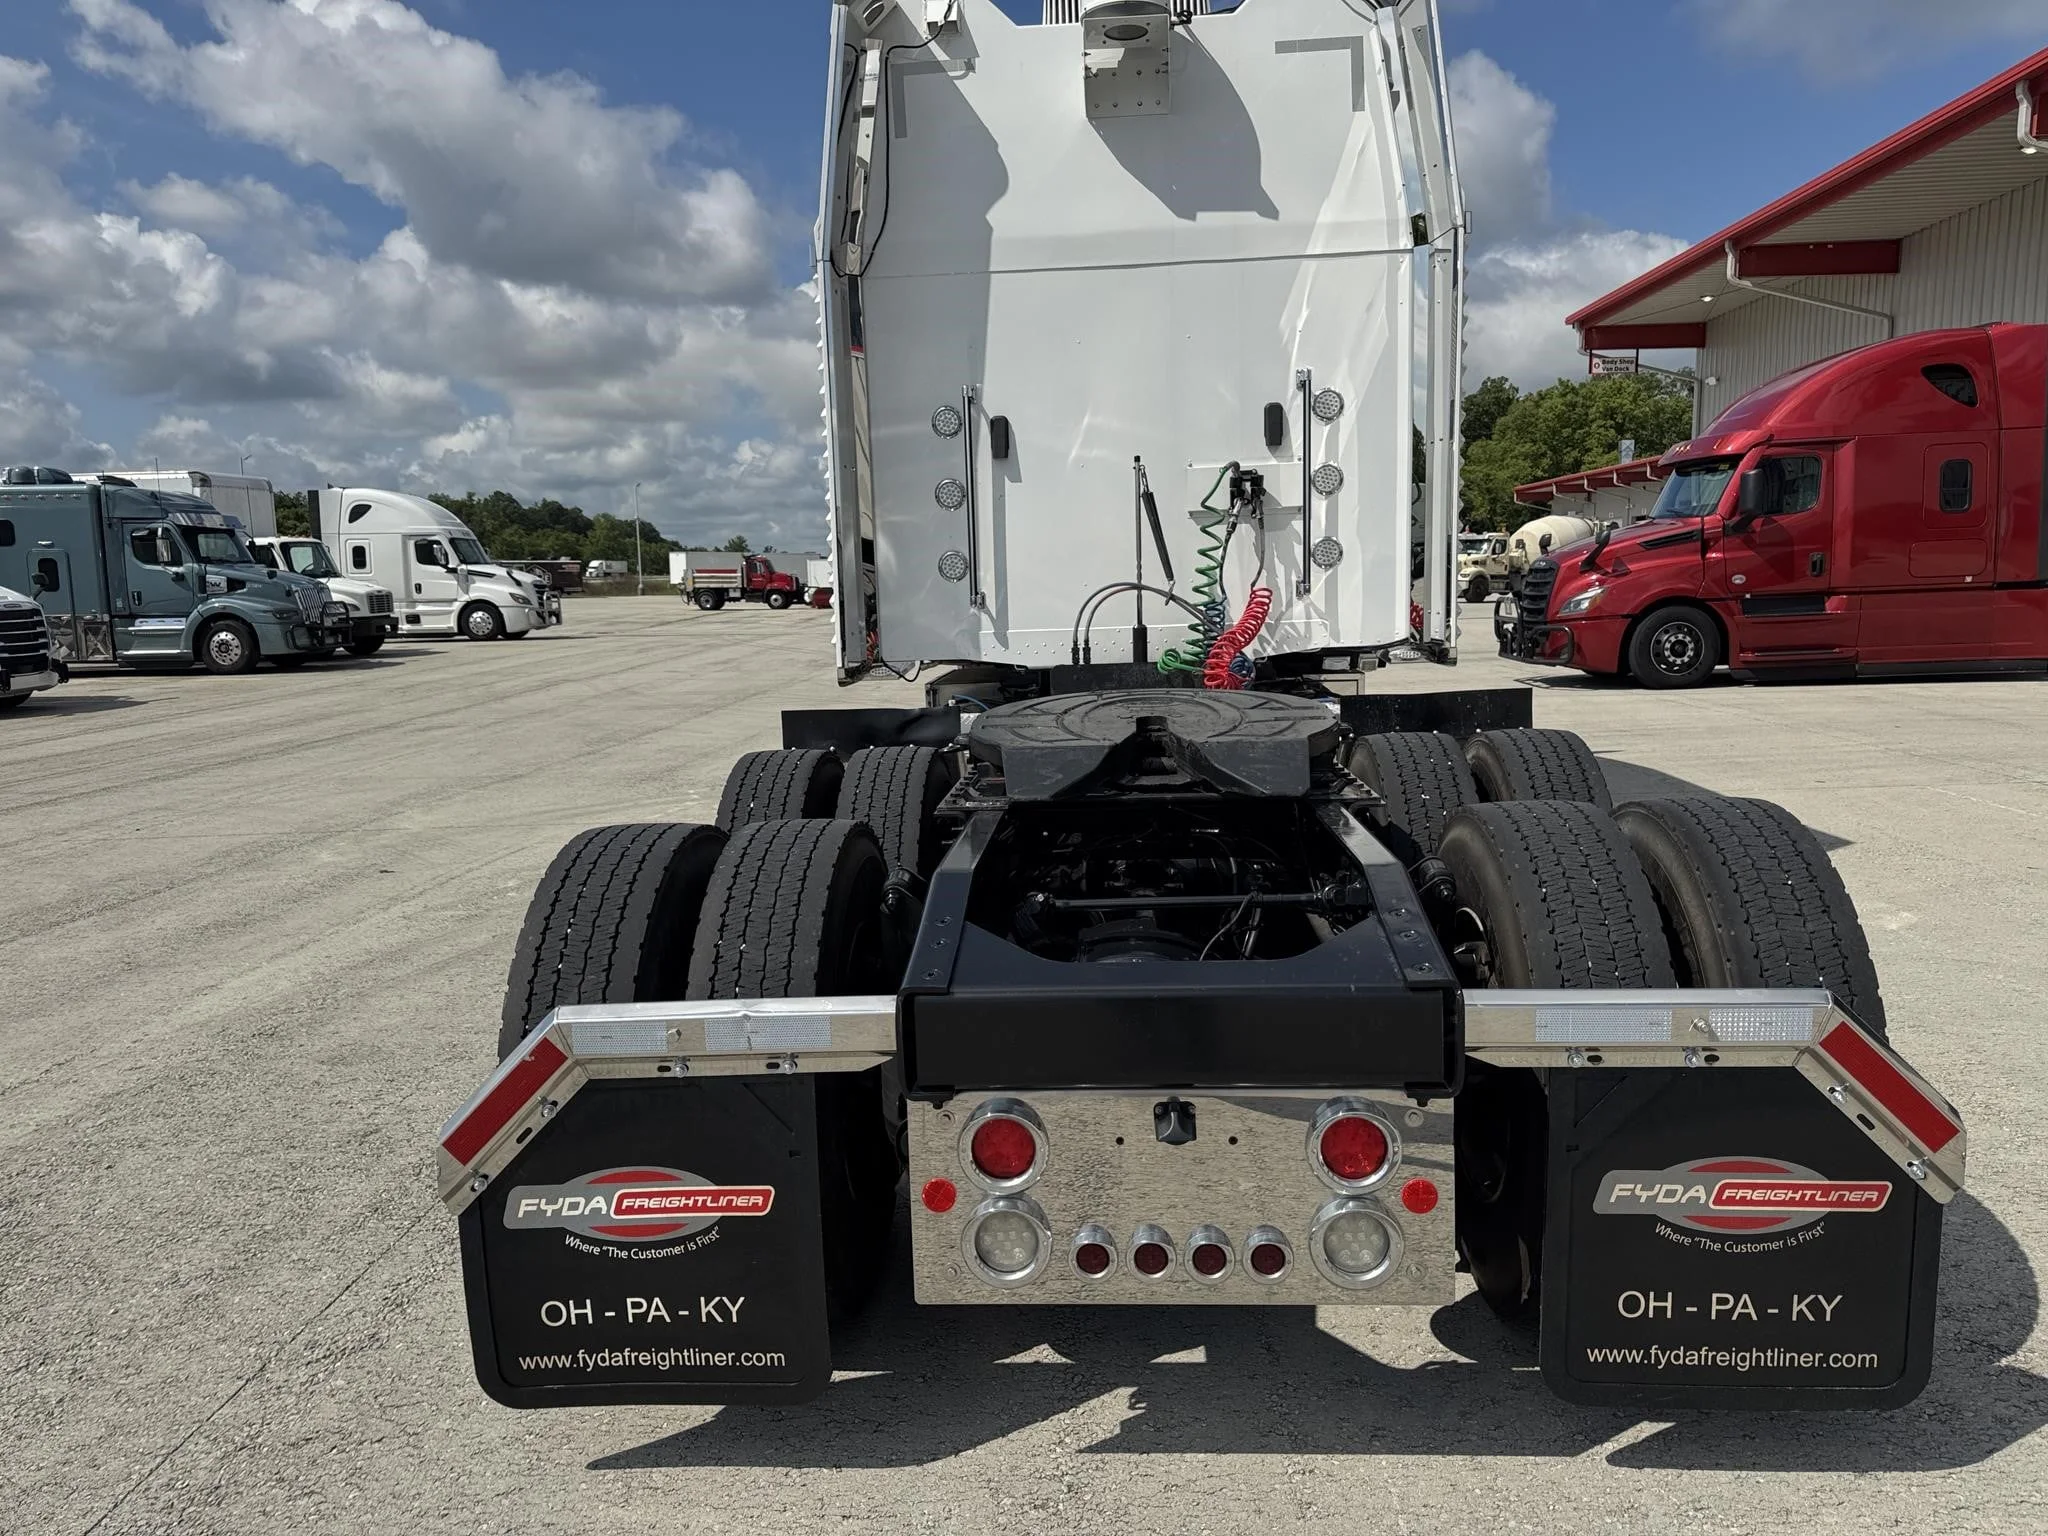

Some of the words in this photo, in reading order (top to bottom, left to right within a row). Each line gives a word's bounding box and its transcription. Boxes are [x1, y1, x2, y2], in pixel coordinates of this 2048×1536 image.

[622, 1195, 763, 1209] FREIGHTLINER
[1610, 1183, 1706, 1203] FYDA
[1722, 1188, 1878, 1202] FREIGHTLINER
[517, 1196, 607, 1218] FYDA
[565, 1234, 600, 1256] Where
[631, 1245, 685, 1259] Customer
[686, 1241, 696, 1251] is
[1656, 1222, 1692, 1246] Where
[1724, 1238, 1784, 1253] Customer
[1787, 1236, 1797, 1246] is
[541, 1299, 593, 1327] OH
[626, 1298, 671, 1323] PA
[700, 1297, 745, 1323] KY
[1617, 1291, 1672, 1318] OH
[1711, 1293, 1757, 1320] PA
[1791, 1294, 1842, 1321] KY
[519, 1349, 785, 1371] www.fydafreightliner.com
[1587, 1346, 1877, 1371] www.fydafreightliner.com
